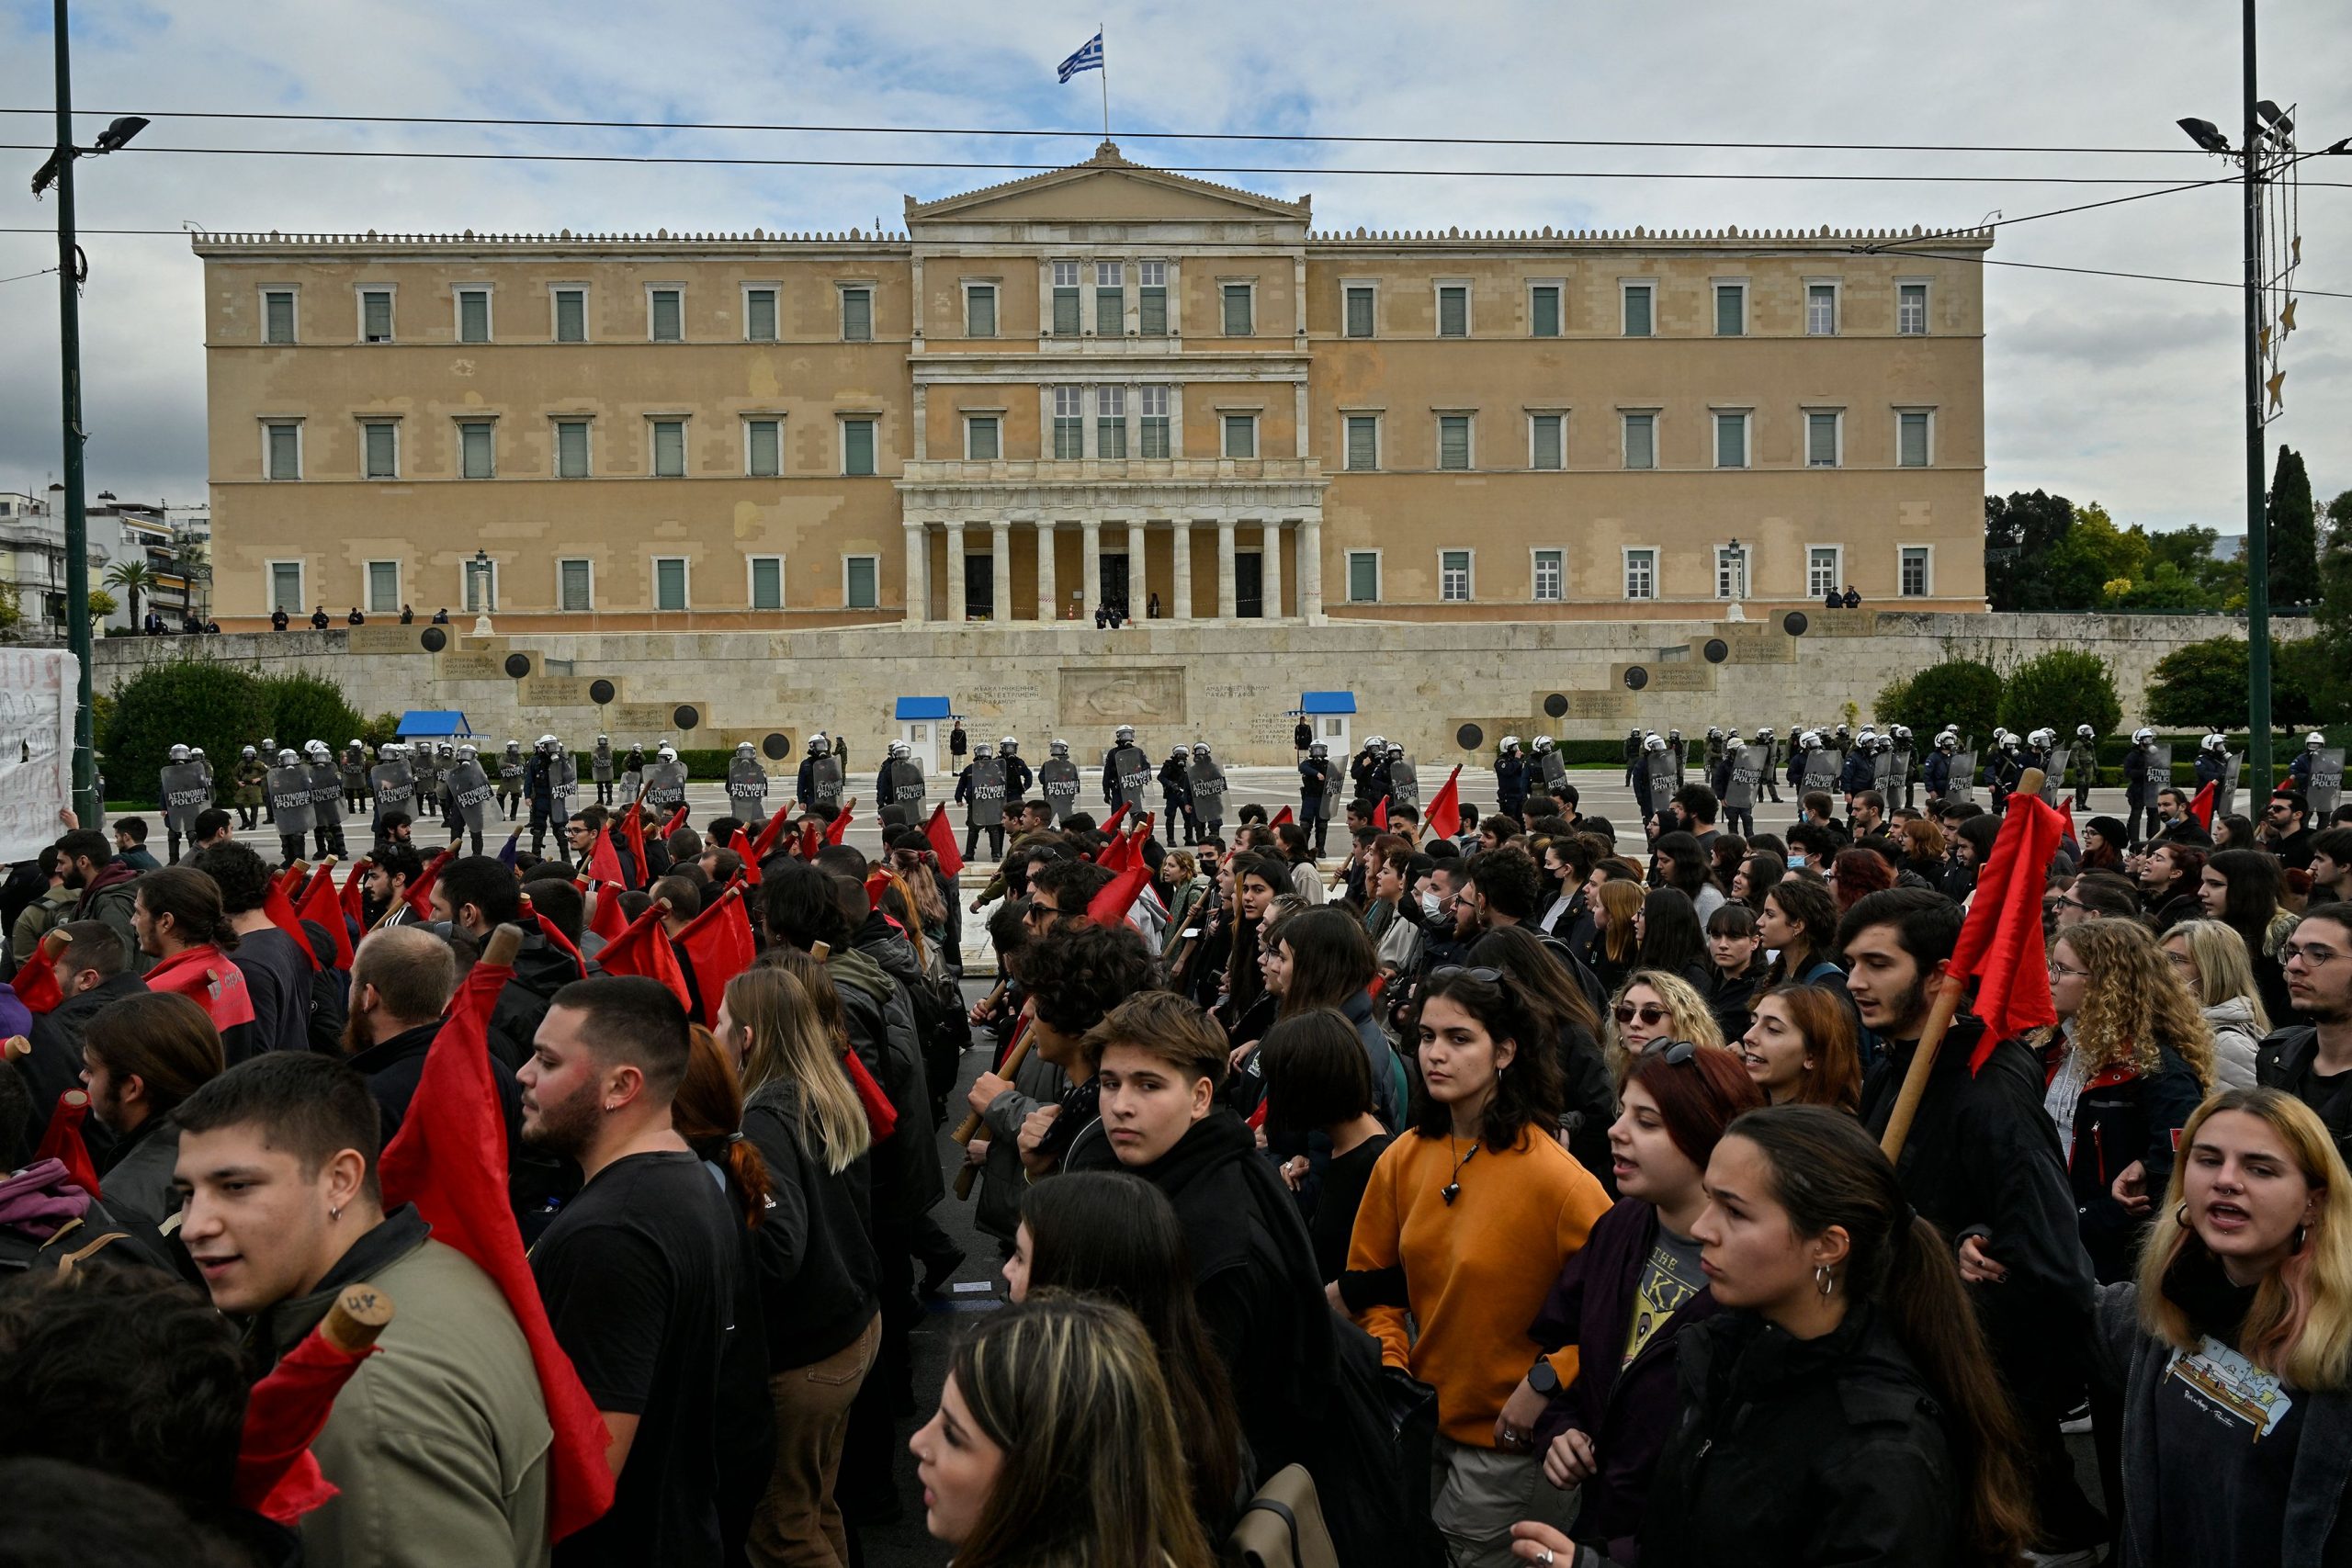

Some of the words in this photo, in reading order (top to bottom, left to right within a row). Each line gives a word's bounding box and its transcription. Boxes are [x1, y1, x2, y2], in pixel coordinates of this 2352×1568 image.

[1123, 775, 1150, 789] POLICE
[1733, 775, 1759, 784] POLICE
[378, 784, 413, 798] ΑΣΤΥΝΟΜΙΑ
[647, 787, 683, 798] ΑΣΤΥΝΟΜΙΑ
[731, 783, 767, 791] ΑΣΤΥΝΟΜΙΑ
[974, 784, 1006, 795] ΑΣΤΥΝΟΜΙΑ
[1195, 785, 1225, 797] POLICE
[168, 788, 208, 801] ΑΣΤΥΝΟΜΙΑ
[274, 790, 311, 803] ΑΣΤΥΝΟΜΙΑ
[380, 791, 413, 804] POLICE
[458, 784, 491, 803] ΑΣΤΥΝΟΜΙΑ
[461, 791, 492, 808] POLICE
[649, 795, 682, 804] POLICE
[898, 791, 924, 801] POLICE
[976, 792, 1005, 800] POLICE
[171, 795, 207, 807] POLICE
[276, 797, 311, 808] POLICE
[1652, 1247, 1678, 1270] THE
